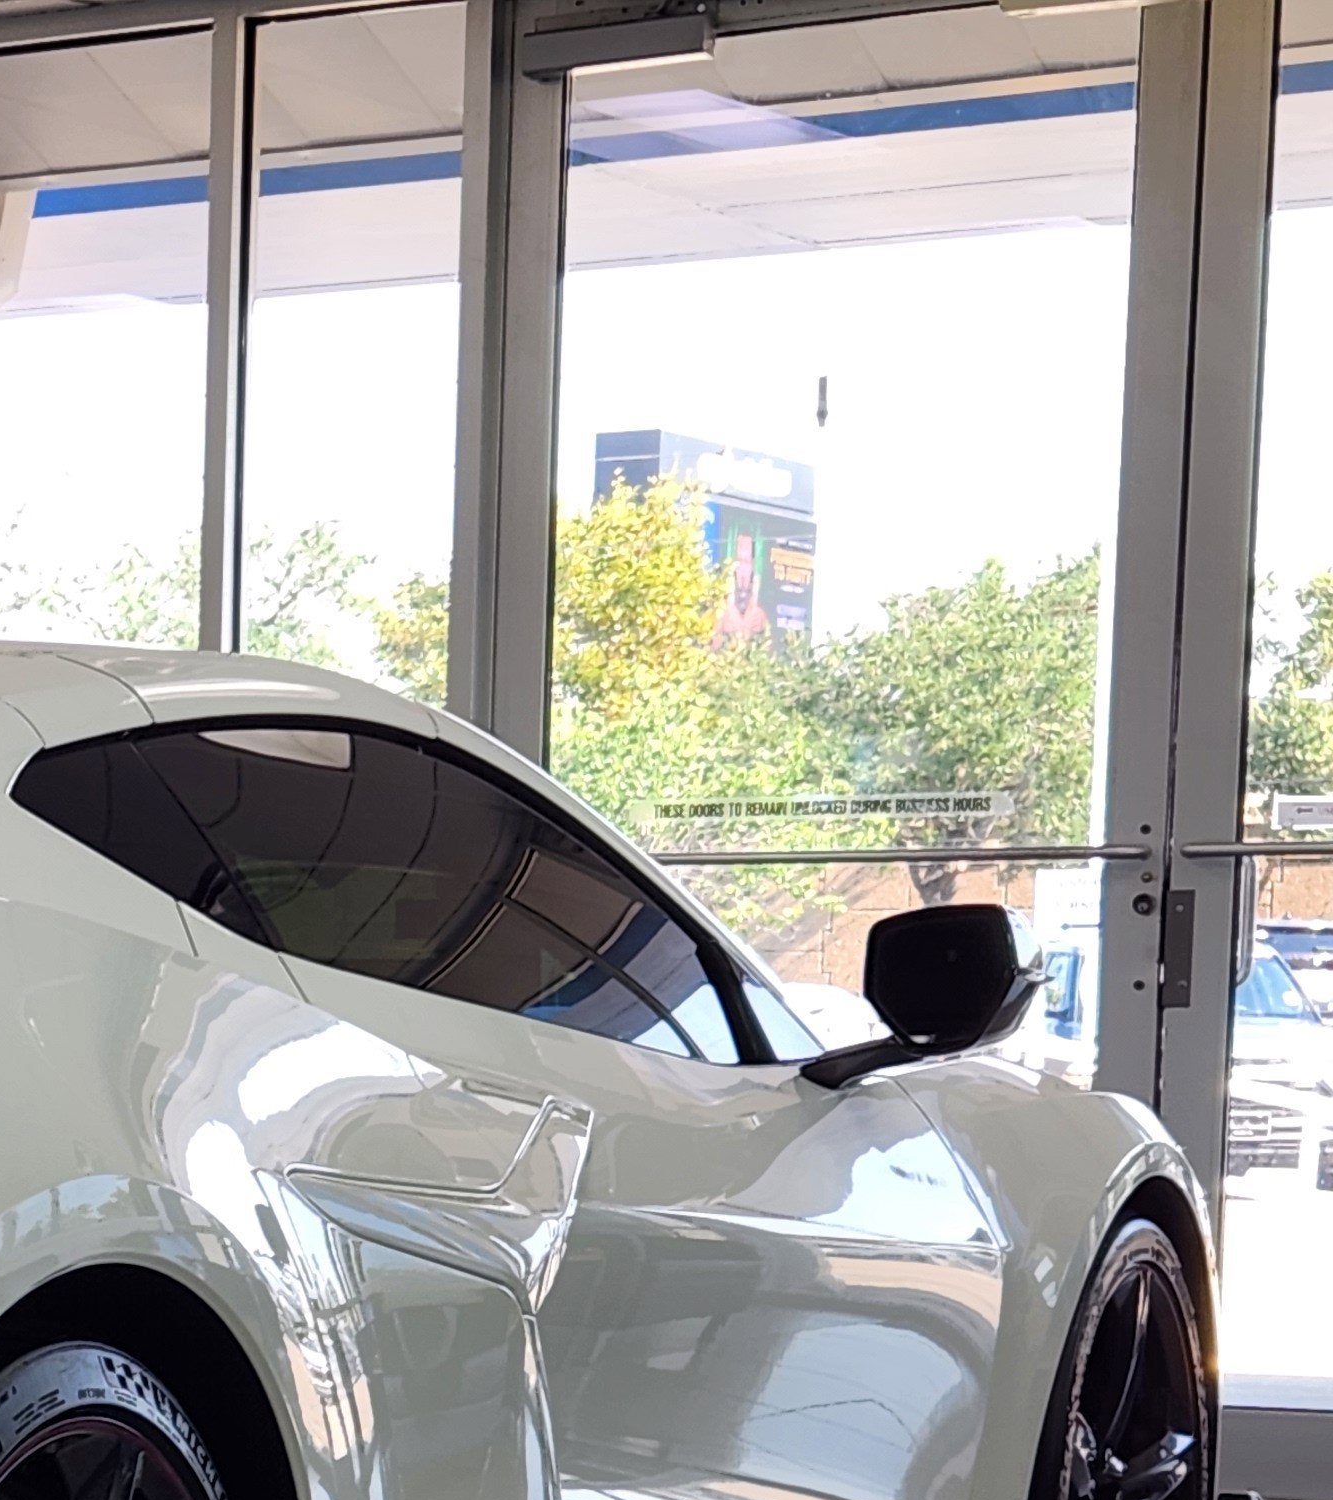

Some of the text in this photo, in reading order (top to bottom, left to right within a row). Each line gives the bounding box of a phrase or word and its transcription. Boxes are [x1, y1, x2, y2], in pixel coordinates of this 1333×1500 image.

[653, 803, 686, 819] THESE
[688, 802, 725, 818] DOORS
[728, 802, 743, 818] TO
[745, 801, 788, 817] REMAIN
[952, 797, 992, 812] HOURS
